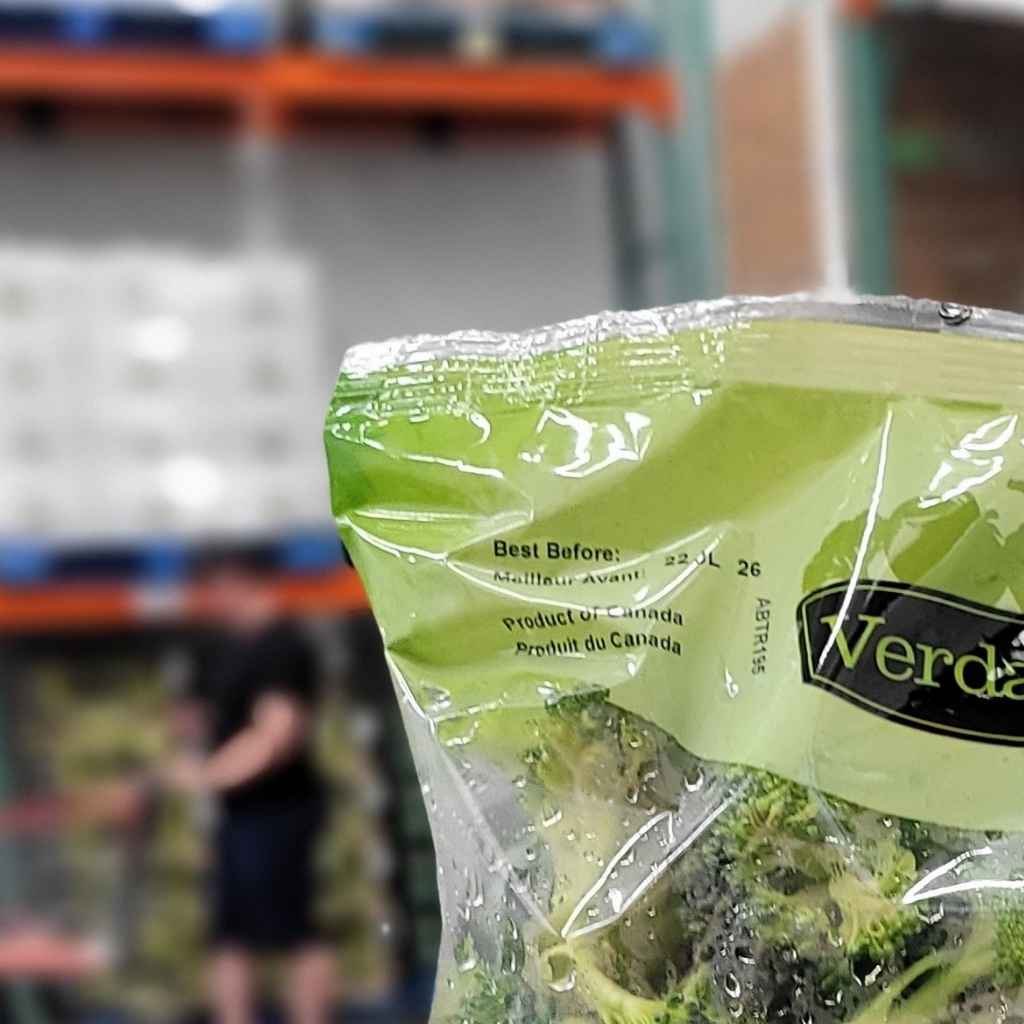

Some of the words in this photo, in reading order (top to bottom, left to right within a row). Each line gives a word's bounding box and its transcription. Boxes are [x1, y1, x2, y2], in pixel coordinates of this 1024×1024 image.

[493, 539, 539, 559] Best
[547, 541, 621, 563] Before:
[664, 552, 689, 567] 22
[737, 558, 761, 578] 26
[502, 608, 575, 632] Product
[515, 637, 579, 658] Produit
[585, 634, 606, 652] du
[610, 631, 682, 656] Canada
